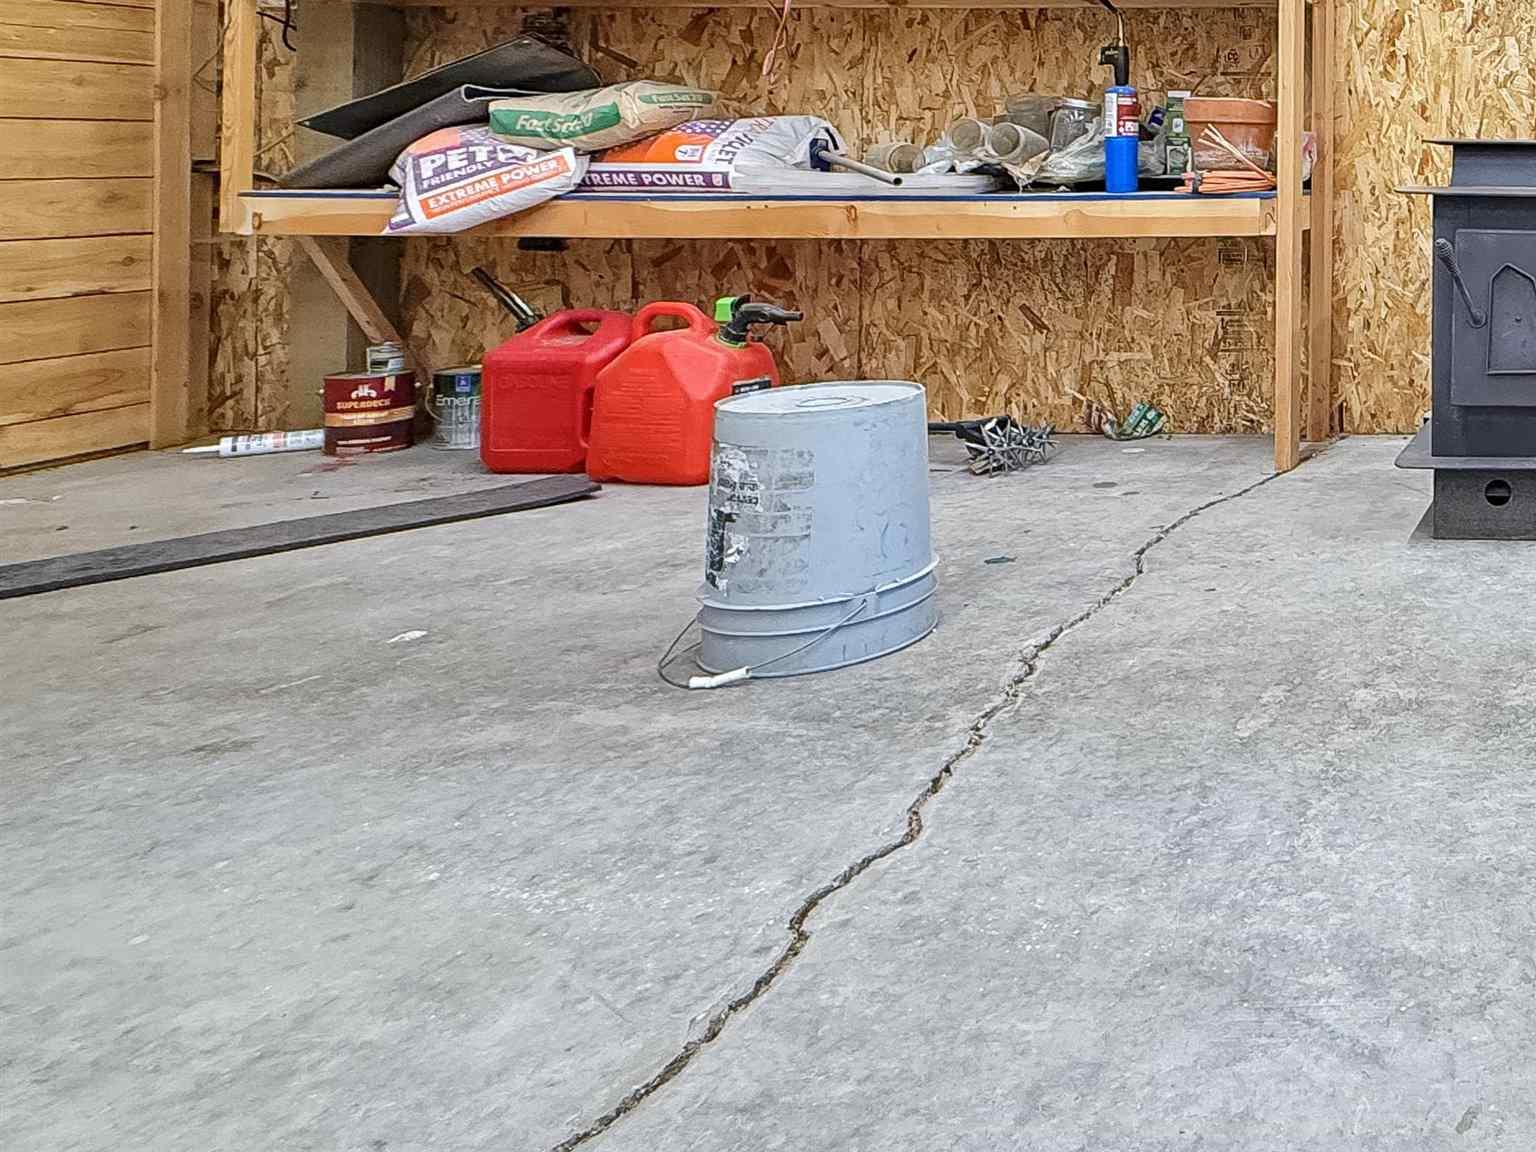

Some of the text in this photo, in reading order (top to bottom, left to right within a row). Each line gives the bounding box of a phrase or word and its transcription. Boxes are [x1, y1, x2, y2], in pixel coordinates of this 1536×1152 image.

[420, 145, 499, 178] PET
[422, 159, 496, 190] FRIENDLY
[428, 158, 560, 210] EXTREME POWER
[642, 173, 706, 187] POWER
[336, 397, 392, 410] SUPERDECK
